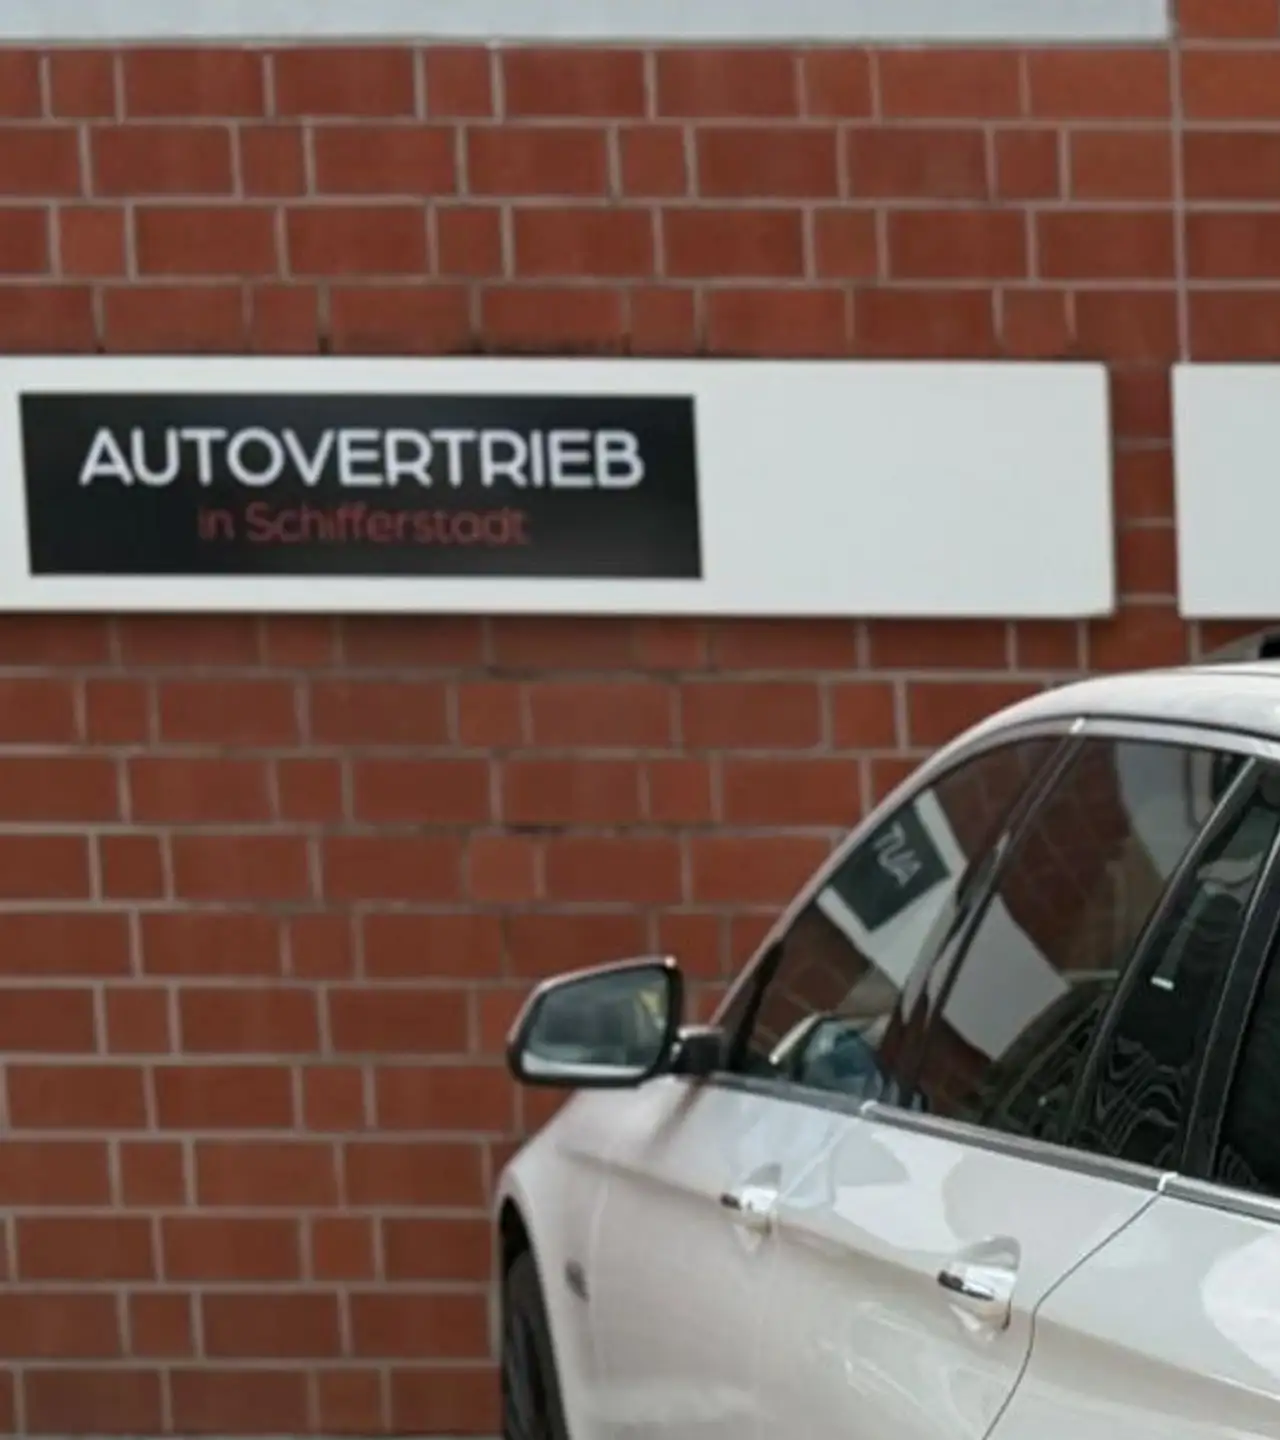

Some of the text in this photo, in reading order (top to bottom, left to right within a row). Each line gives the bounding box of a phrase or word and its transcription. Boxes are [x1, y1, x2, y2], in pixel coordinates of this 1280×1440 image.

[78, 427, 646, 488] AUTOVERTRIEB
[200, 502, 531, 546] in Schifferstadt
